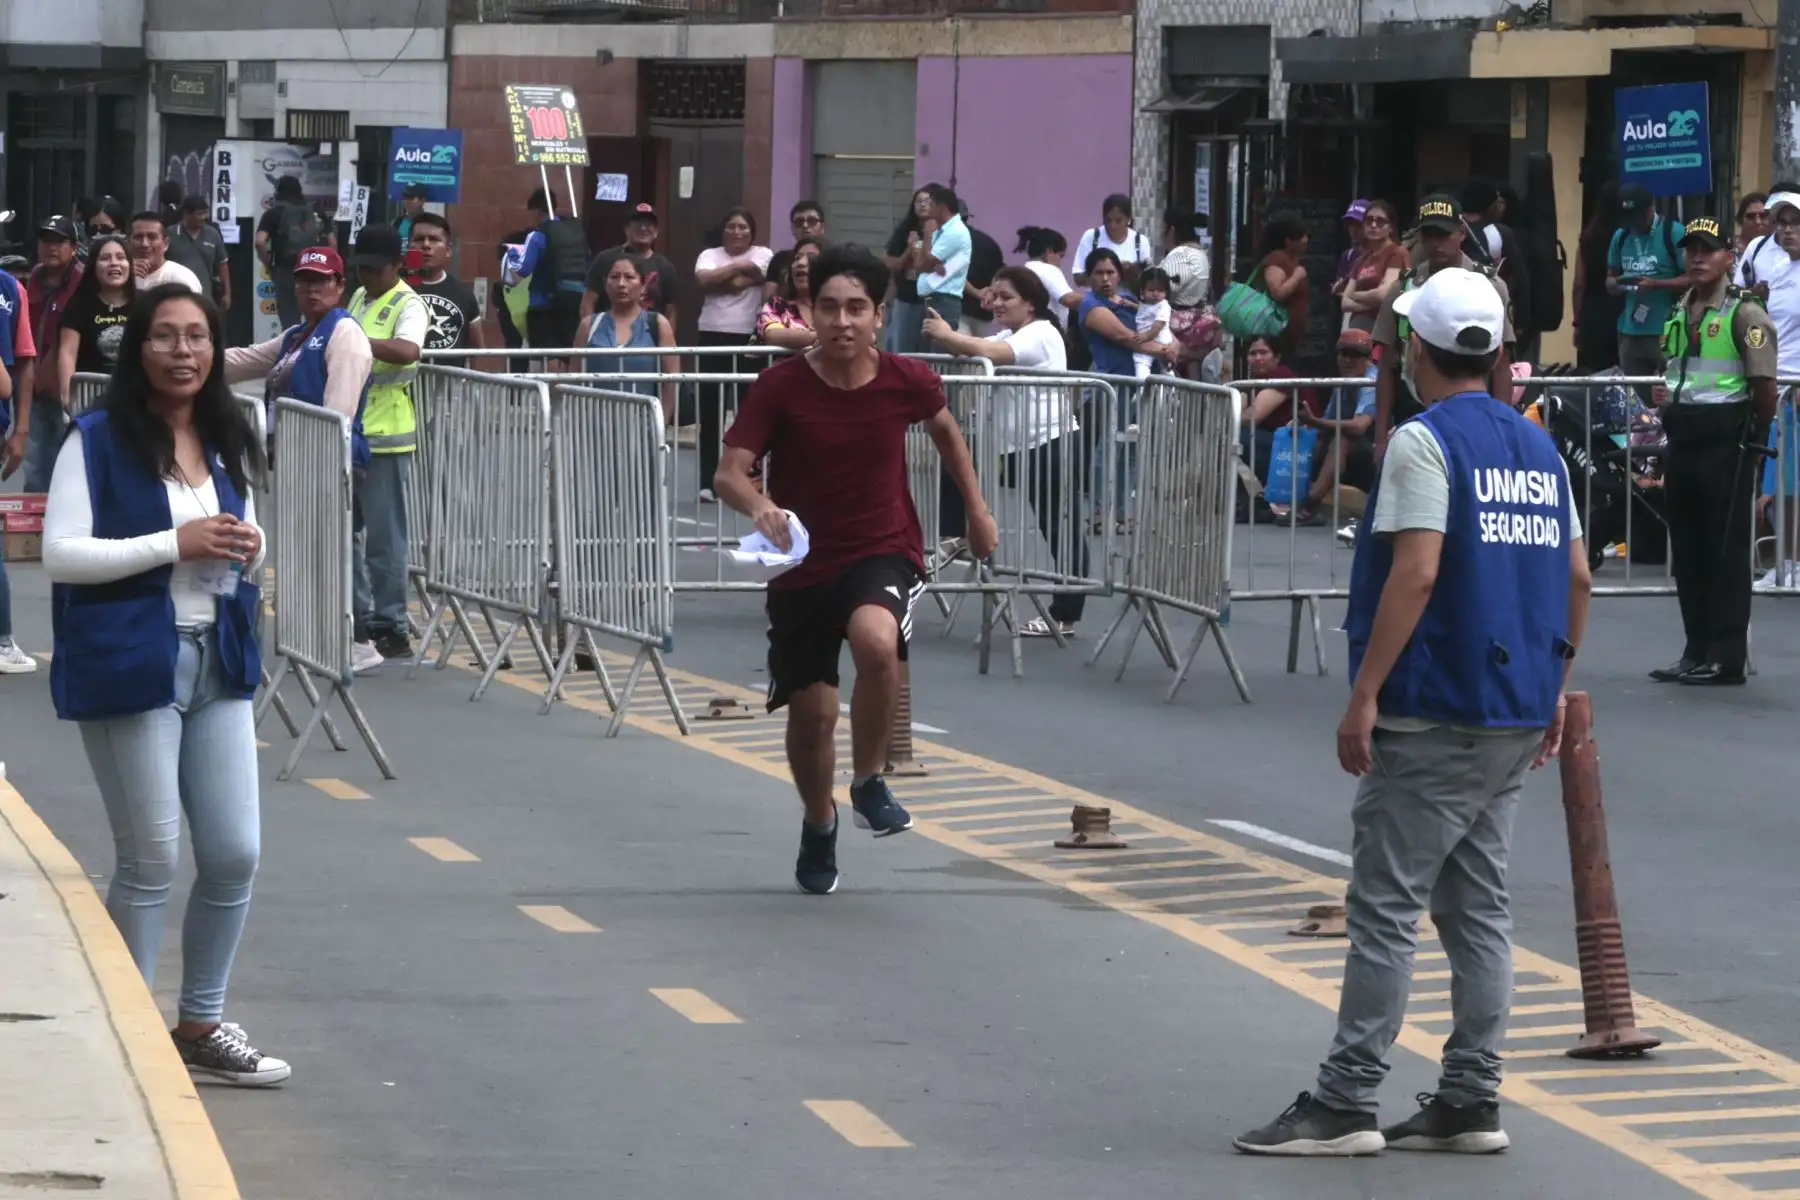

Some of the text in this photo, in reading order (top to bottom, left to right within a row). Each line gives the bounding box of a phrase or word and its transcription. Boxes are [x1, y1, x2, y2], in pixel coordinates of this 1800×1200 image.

[506, 86, 526, 163] ACADEMIA
[527, 106, 568, 140] 100
[1623, 119, 1667, 141] Aula
[395, 147, 431, 163] Aula
[216, 150, 232, 222] BAÑO
[1419, 202, 1453, 219] POLICIA
[1686, 216, 1720, 236] POLICIA
[423, 296, 458, 316] VERSE
[429, 335, 454, 348] STAR
[1474, 467, 1559, 508] UNMSM
[1480, 511, 1560, 548] SEGURIDAD
